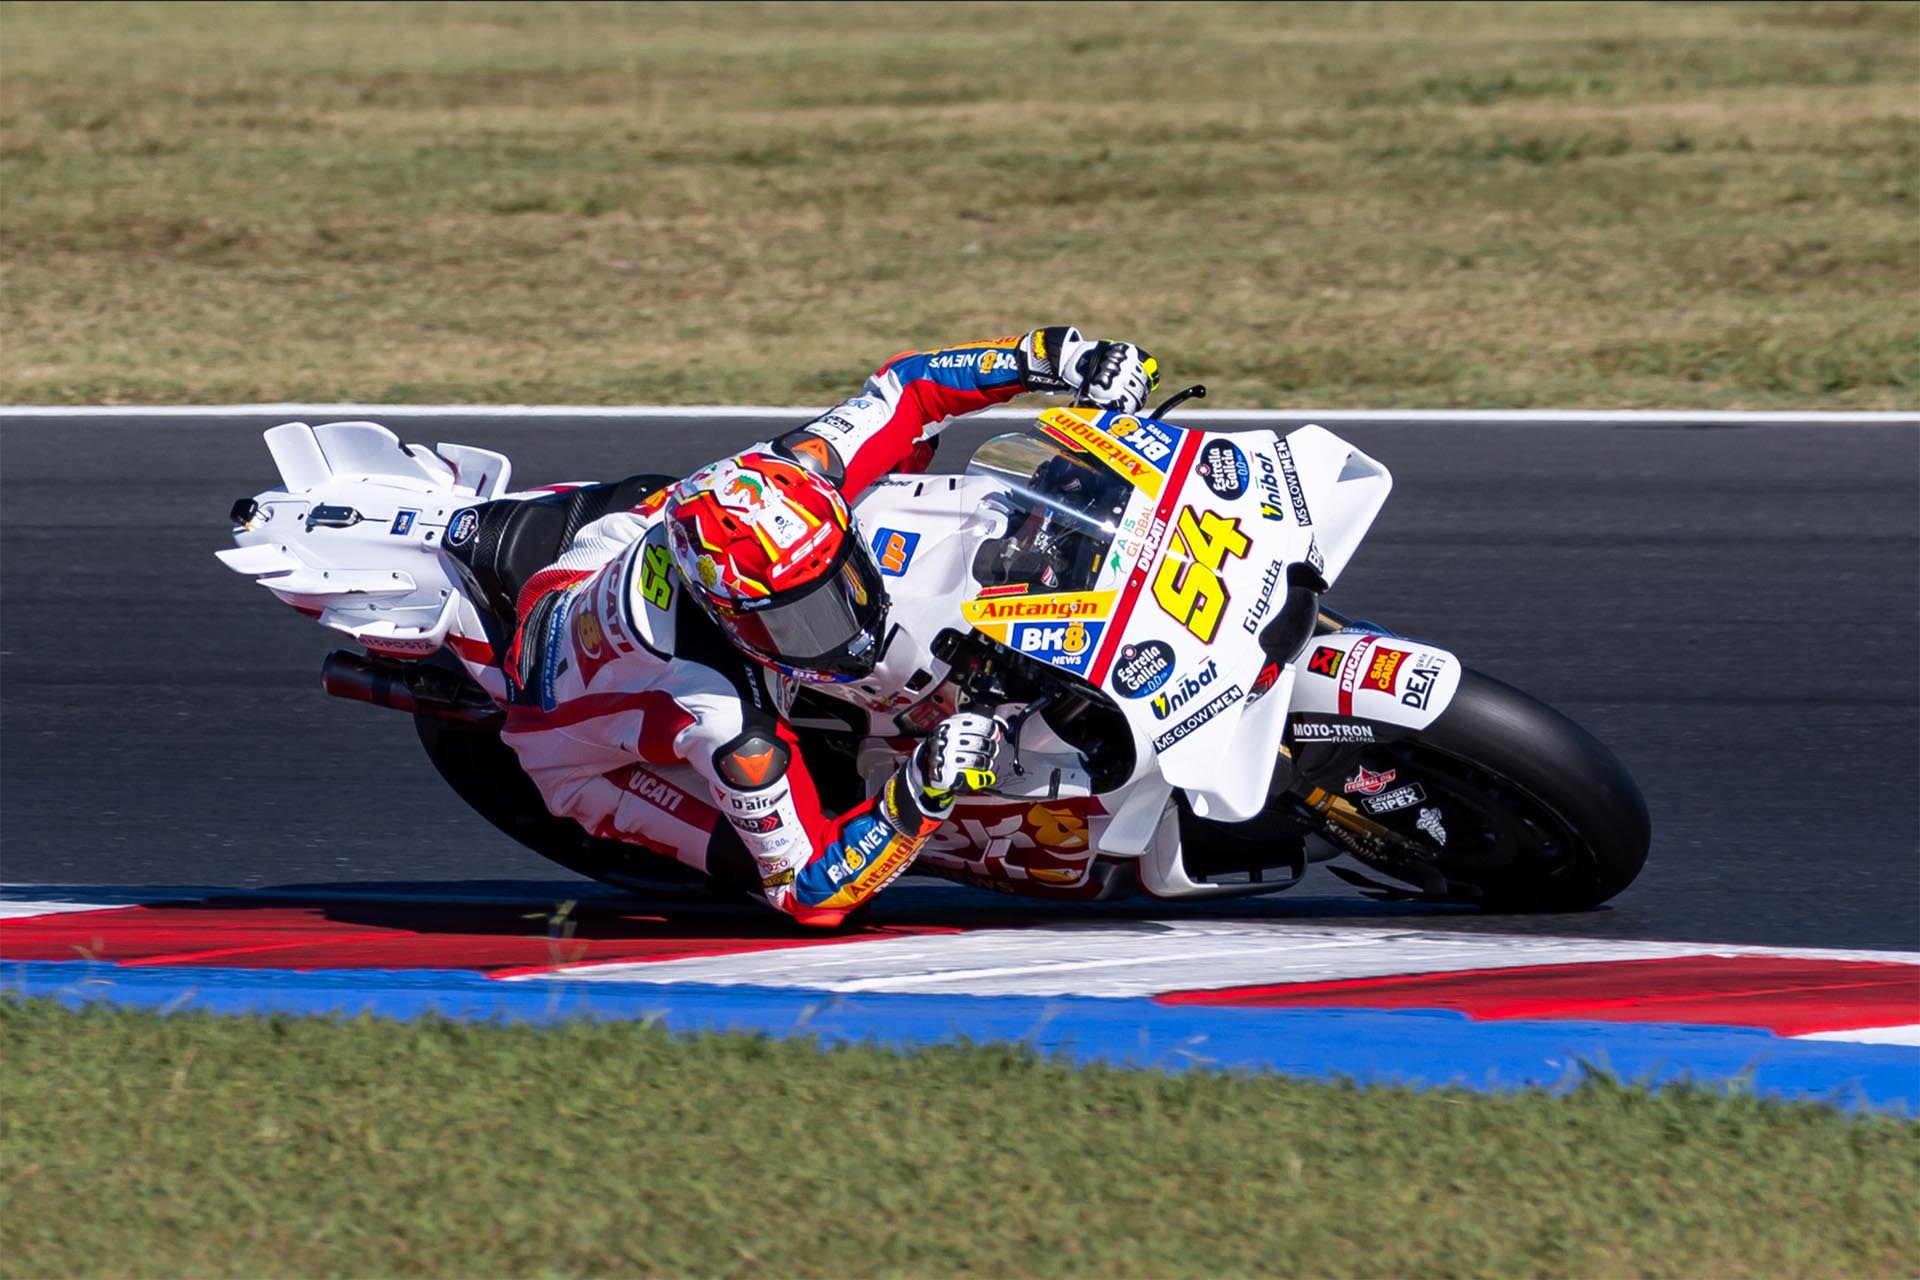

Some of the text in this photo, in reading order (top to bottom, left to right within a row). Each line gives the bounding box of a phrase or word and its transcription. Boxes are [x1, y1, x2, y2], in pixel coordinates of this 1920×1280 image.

[929, 353, 977, 368] NEWS
[1054, 414, 1152, 477] Antangin
[1107, 413, 1171, 462] BK8
[1146, 424, 1173, 445] NEWS
[1208, 447, 1227, 493] Estrella
[1221, 448, 1240, 490] Galicia
[1254, 452, 1284, 522] Unibat
[1137, 516, 1167, 573] DUCATI
[638, 544, 674, 612] 54
[1151, 504, 1254, 645] 54
[980, 599, 1098, 619] Antangin
[1242, 558, 1283, 636] Gigetta
[1020, 622, 1091, 656] BK8
[1051, 655, 1082, 666] NEWS
[1117, 645, 1161, 682] Estrella
[1126, 657, 1168, 691] Galicia
[1341, 641, 1370, 694] DUCATI
[1370, 654, 1386, 680] SAN
[1378, 651, 1401, 690] CARLO
[1150, 659, 1219, 721] Unibat
[1293, 723, 1374, 737] MOTO-TRON
[1372, 791, 1419, 813] SIPEX
[827, 845, 866, 885] BK8
[858, 820, 891, 855] NEW
